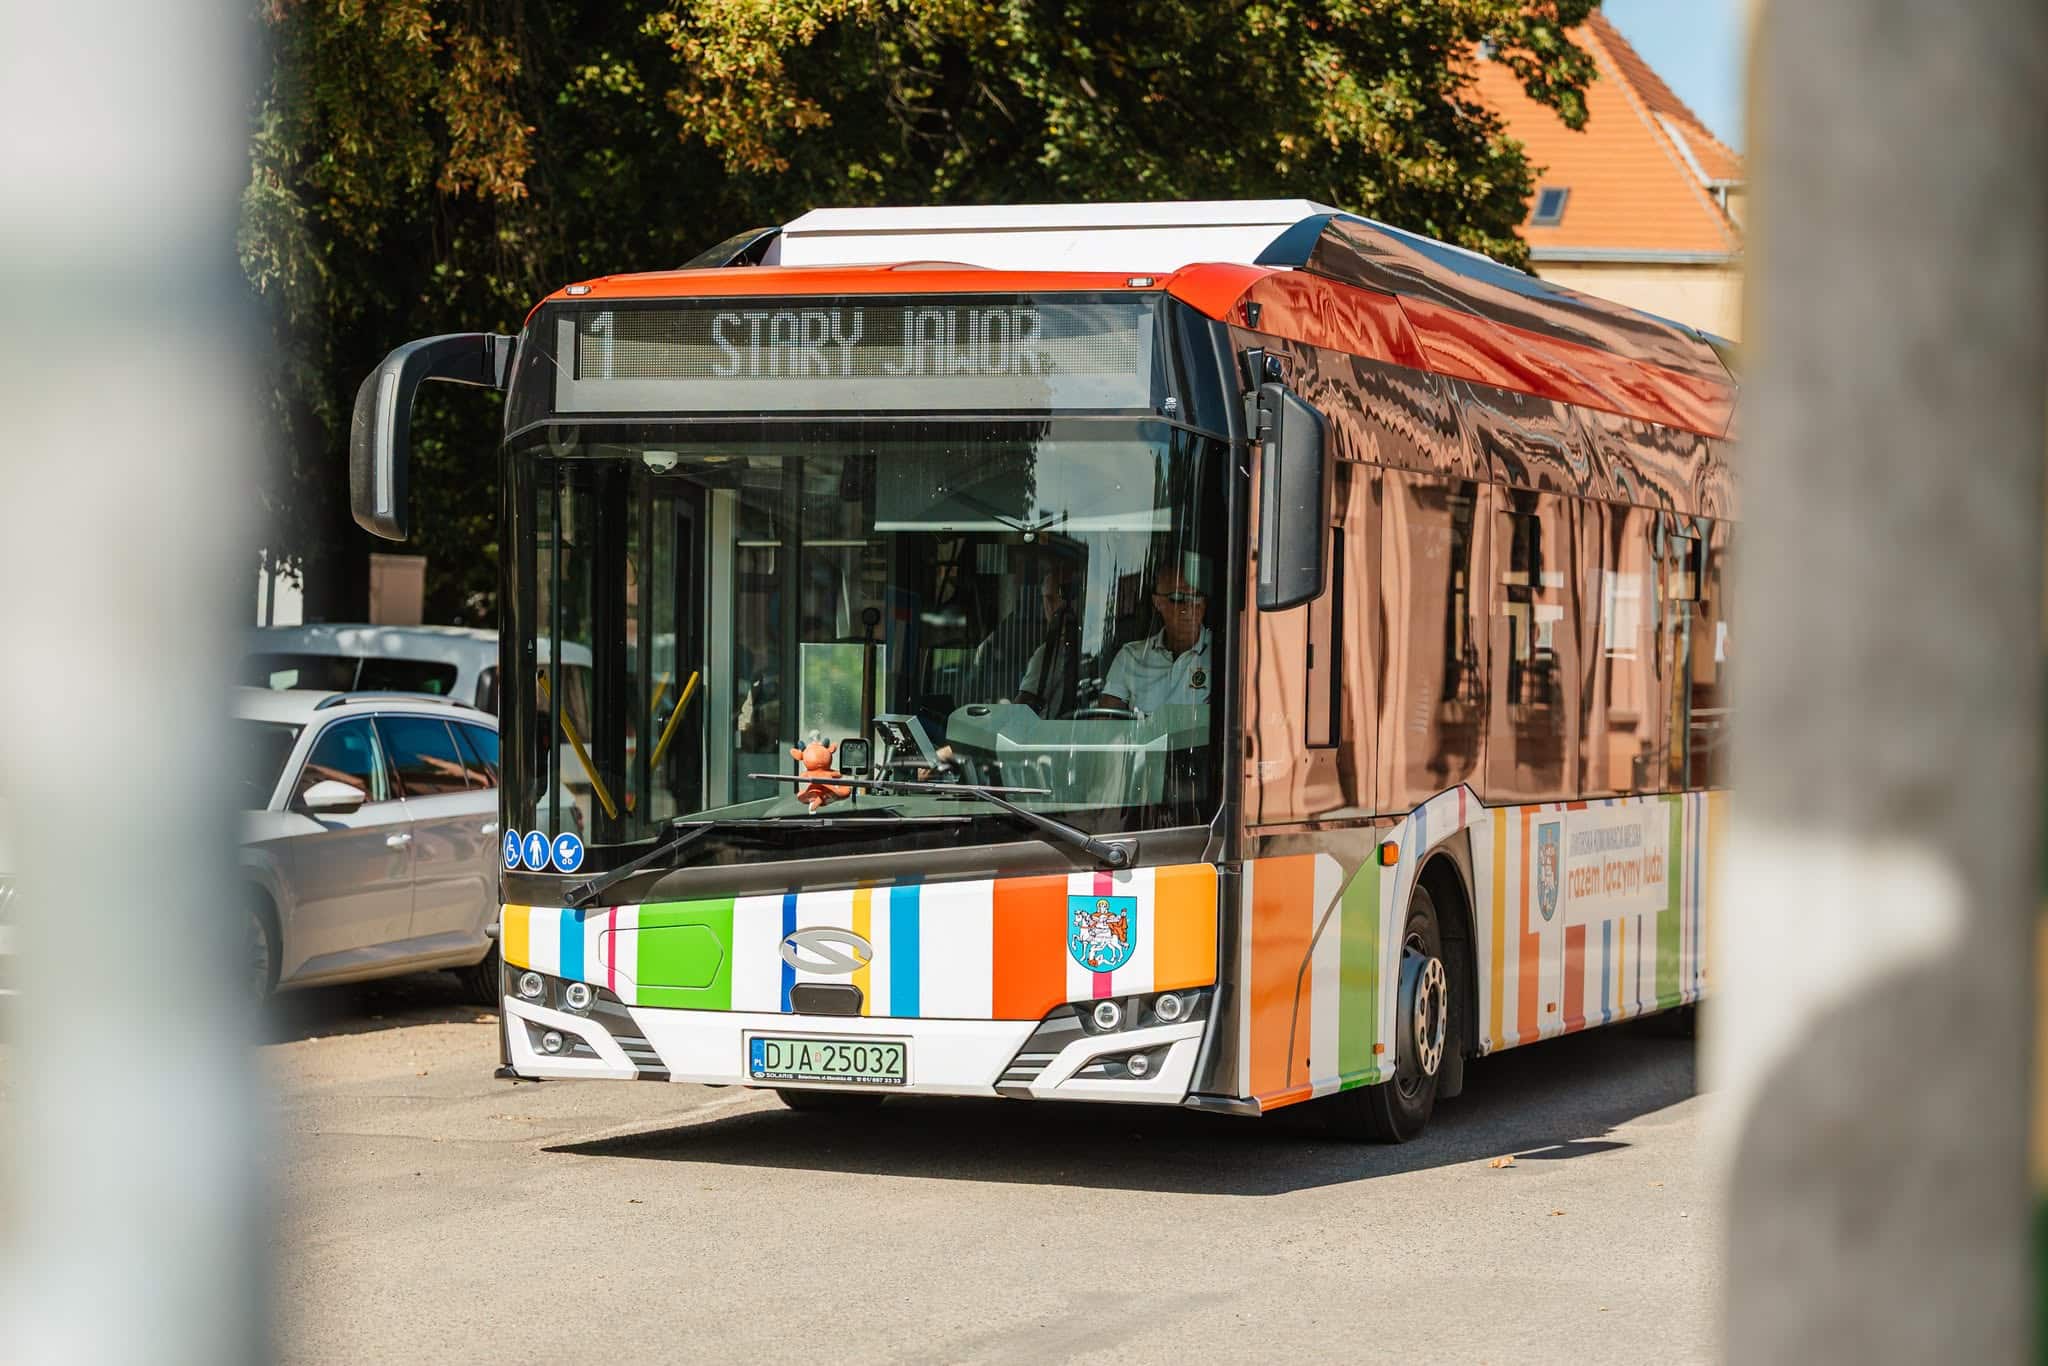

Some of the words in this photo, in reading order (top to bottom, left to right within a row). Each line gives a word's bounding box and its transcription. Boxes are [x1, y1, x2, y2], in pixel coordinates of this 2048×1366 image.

[591, 311, 614, 380] 1
[711, 310, 863, 377] STARY
[884, 308, 1042, 376] JAWOR
[754, 1058, 763, 1067] PL
[766, 1043, 813, 1071] DJA
[822, 1045, 899, 1074] 25032
